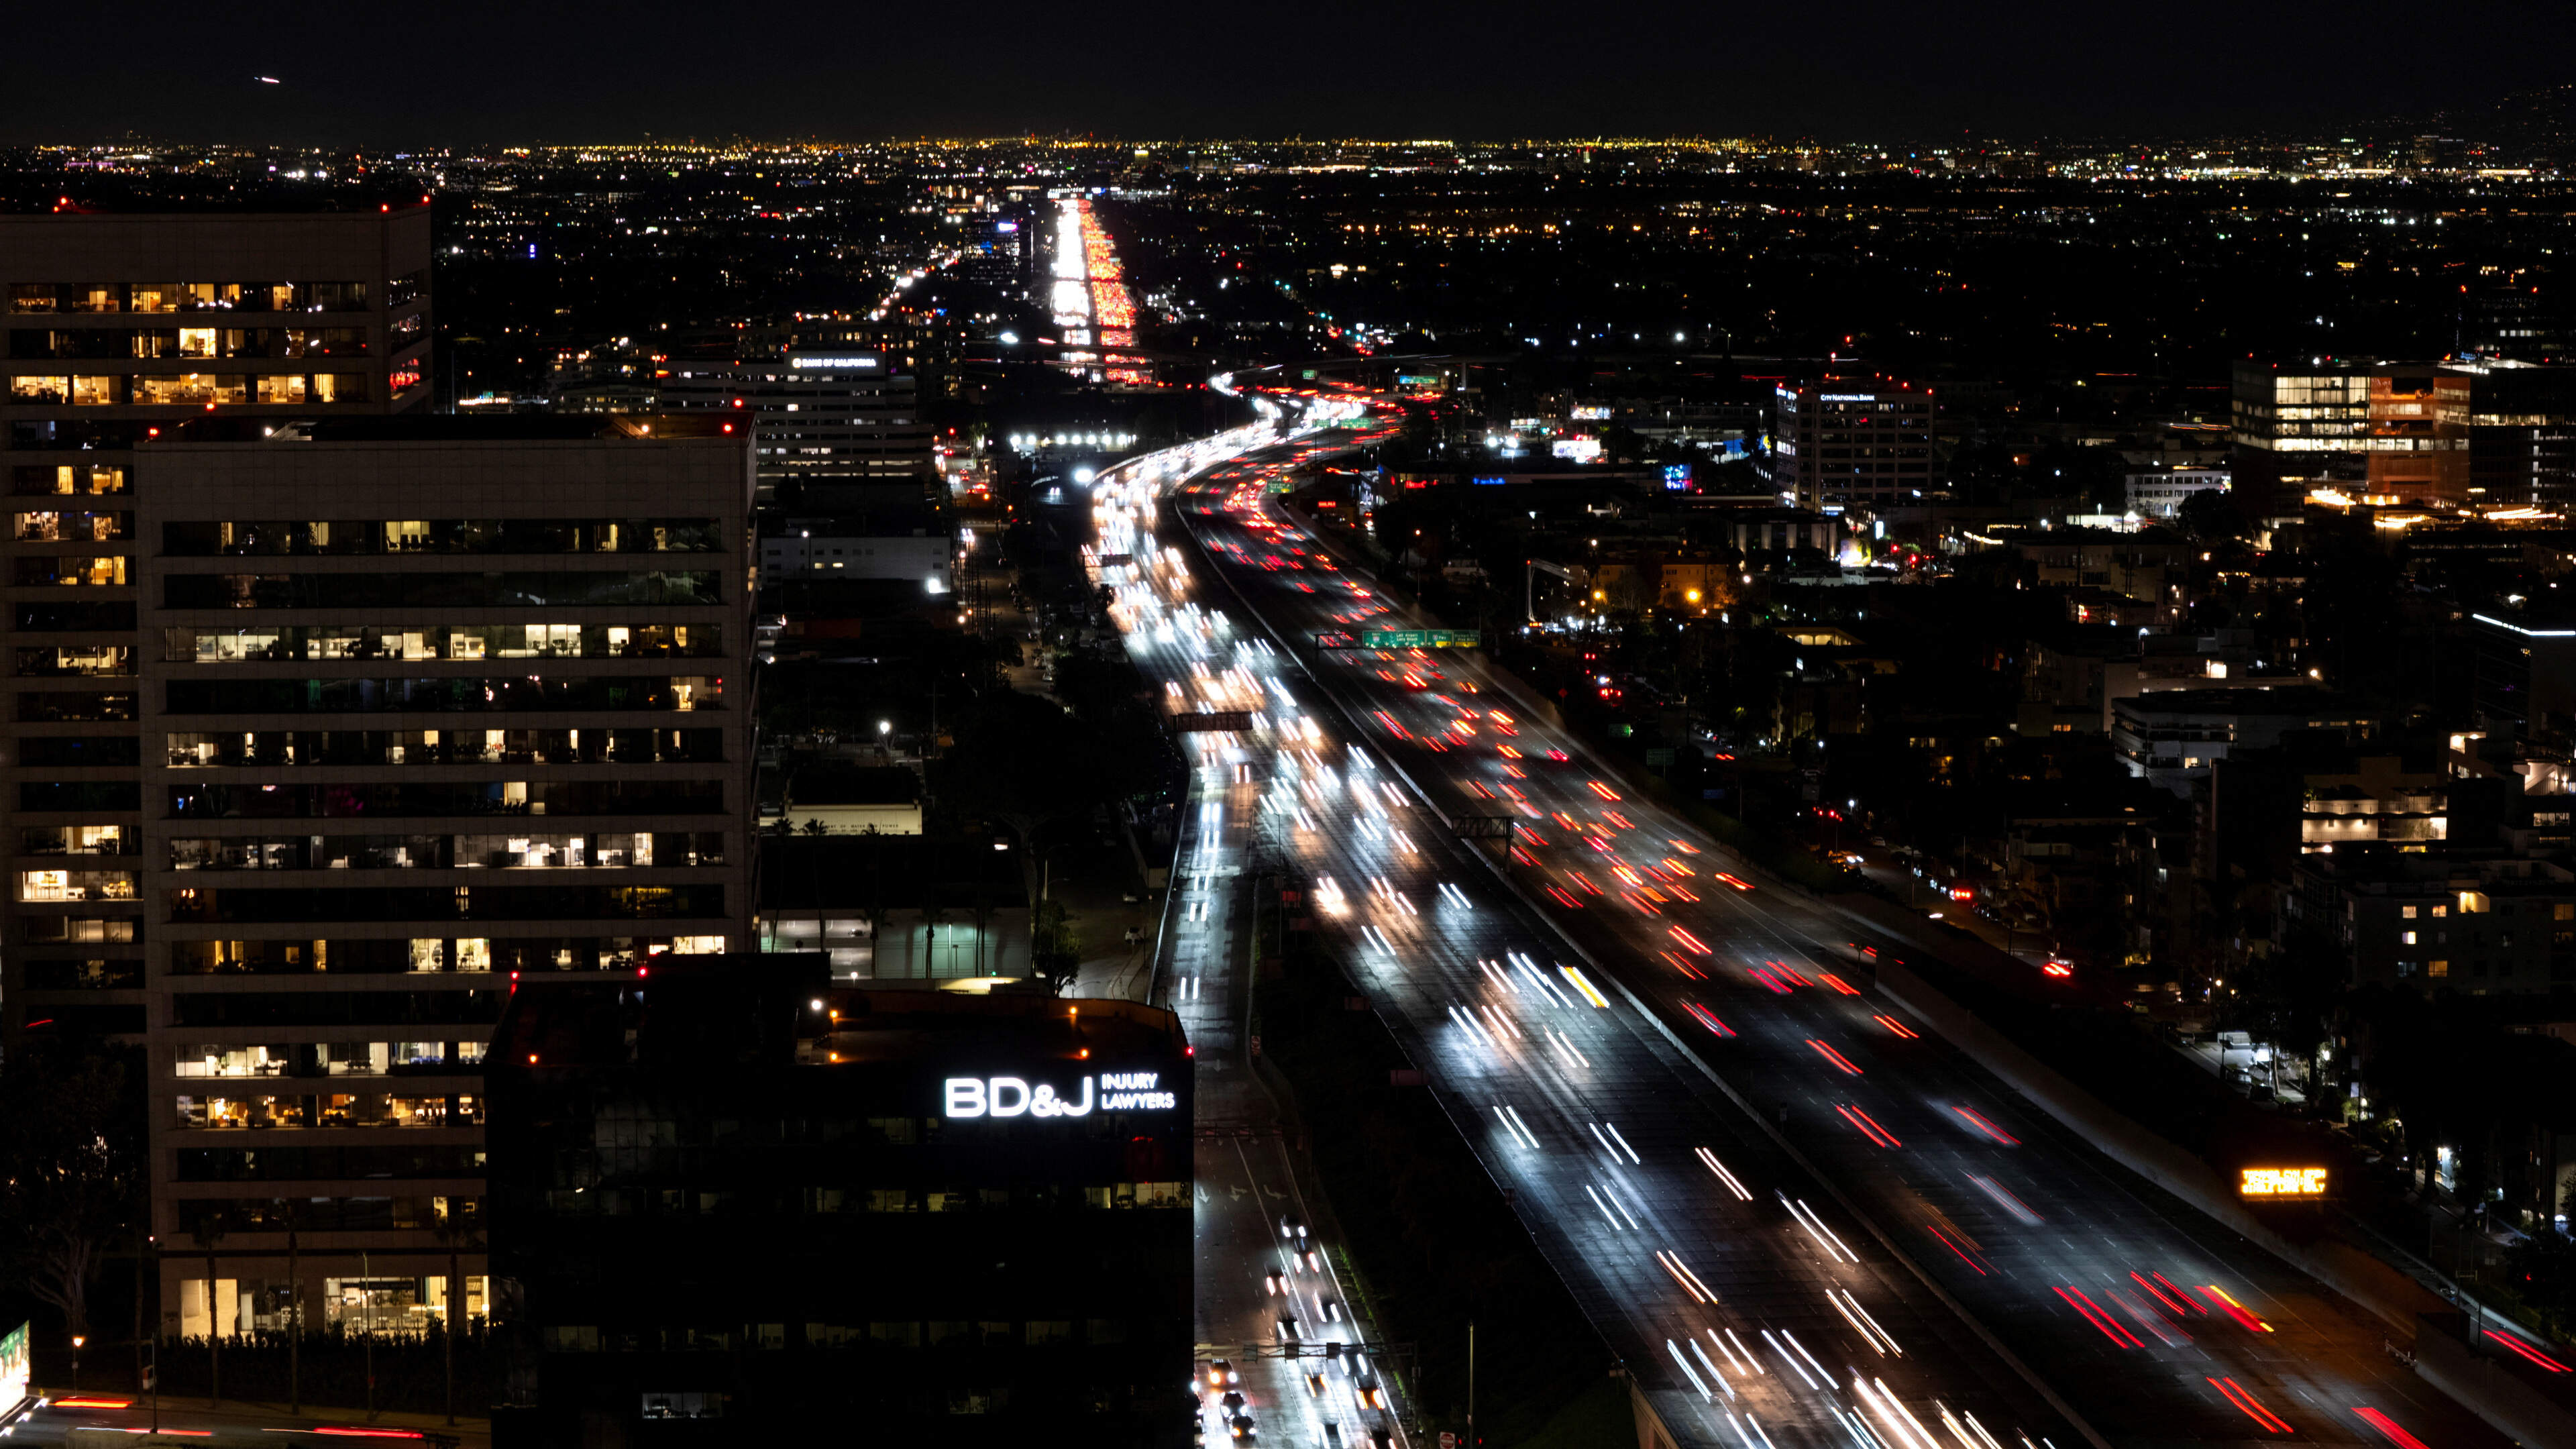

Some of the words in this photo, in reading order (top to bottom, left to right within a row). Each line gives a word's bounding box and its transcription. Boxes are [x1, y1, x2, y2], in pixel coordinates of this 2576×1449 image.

[1101, 1073, 1159, 1089] INJURY
[945, 1076, 1093, 1118] BD&J
[1101, 1092, 1175, 1110] LAWYERS
